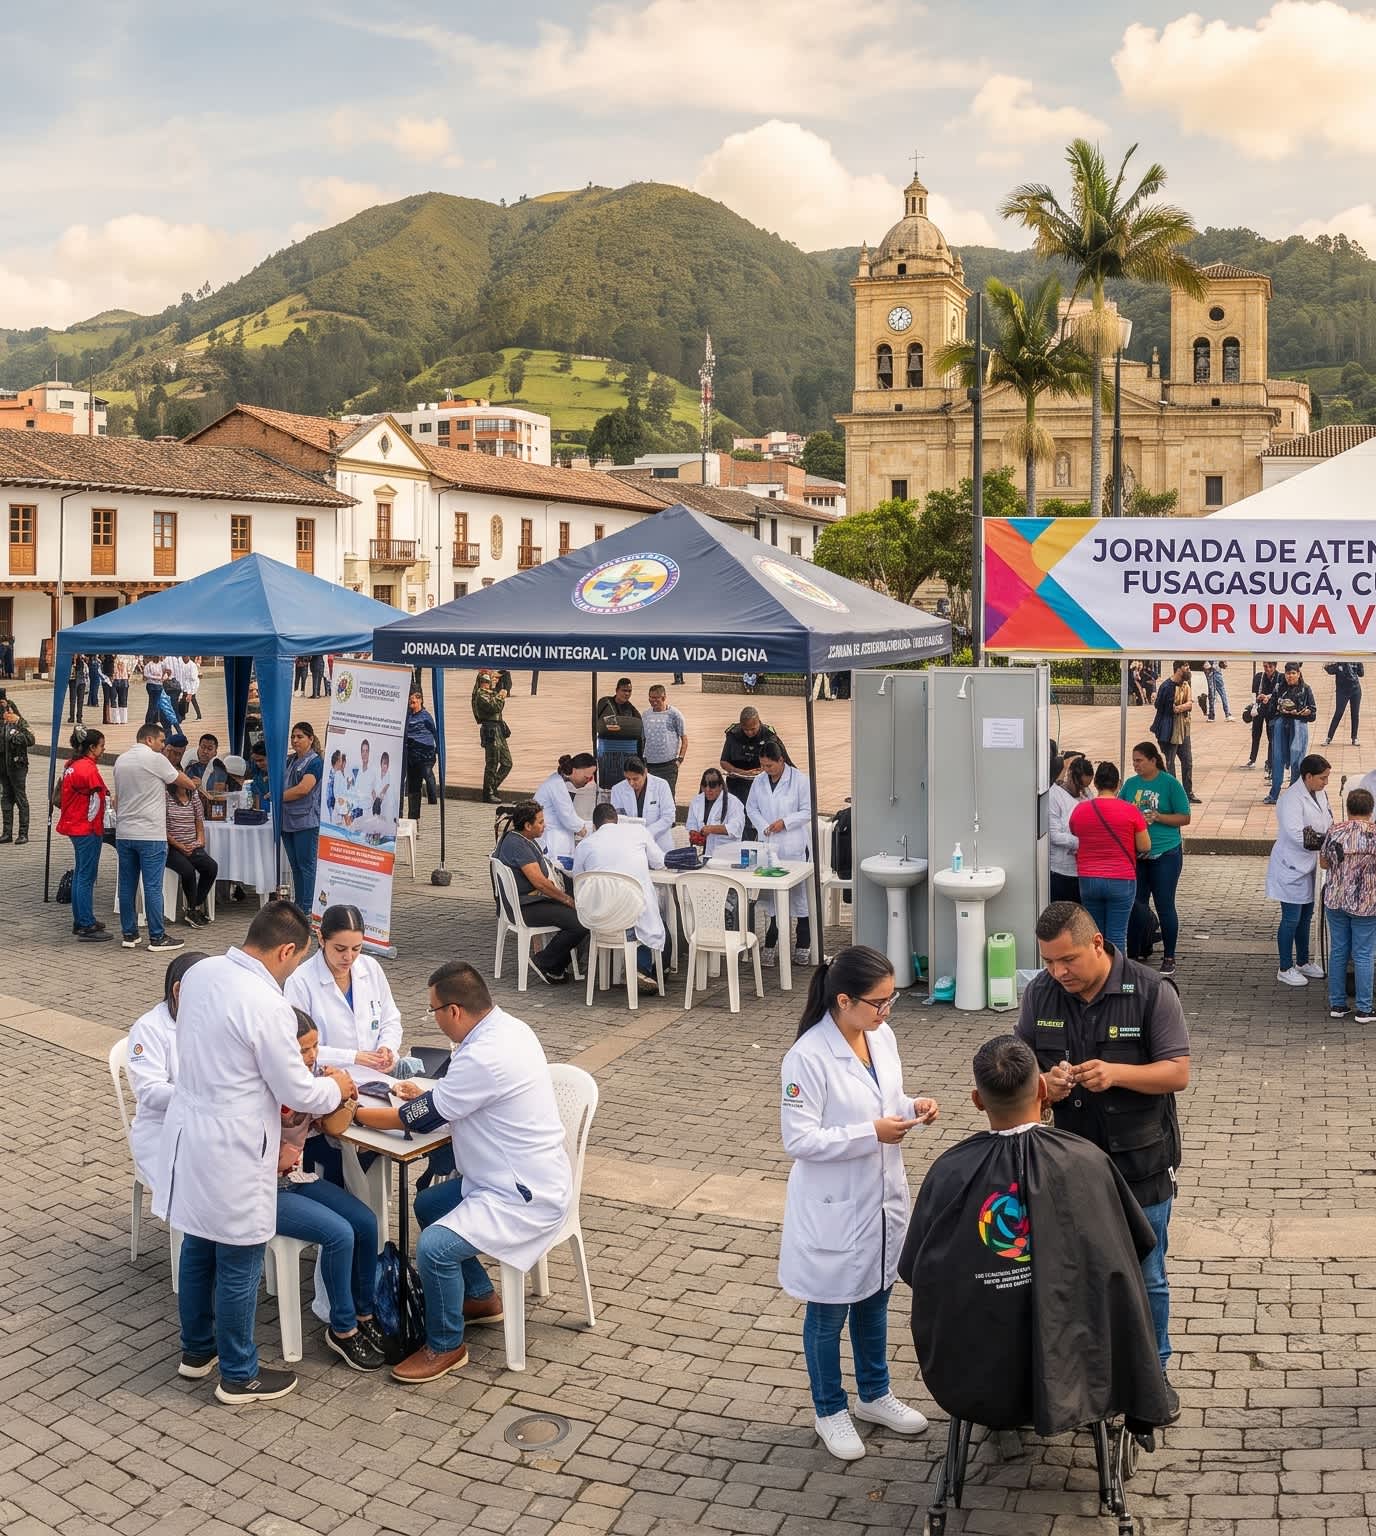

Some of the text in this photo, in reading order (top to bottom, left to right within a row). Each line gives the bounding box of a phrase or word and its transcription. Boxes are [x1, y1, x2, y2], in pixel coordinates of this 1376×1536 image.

[1093, 539, 1246, 563] JORNADA
[1256, 540, 1296, 563] DE
[1124, 565, 1342, 600] FUSAGASUGÁ,
[1152, 603, 1235, 634] POR
[1250, 604, 1336, 635] UNA
[402, 641, 456, 656] JORNADA
[460, 643, 475, 657] DE
[478, 641, 541, 659] ATENCIÓN
[545, 646, 608, 660] INTEGRAL
[620, 646, 646, 661] POR
[651, 647, 679, 661] UNA
[683, 647, 717, 662] VIDA
[722, 648, 768, 663] DIGNA
